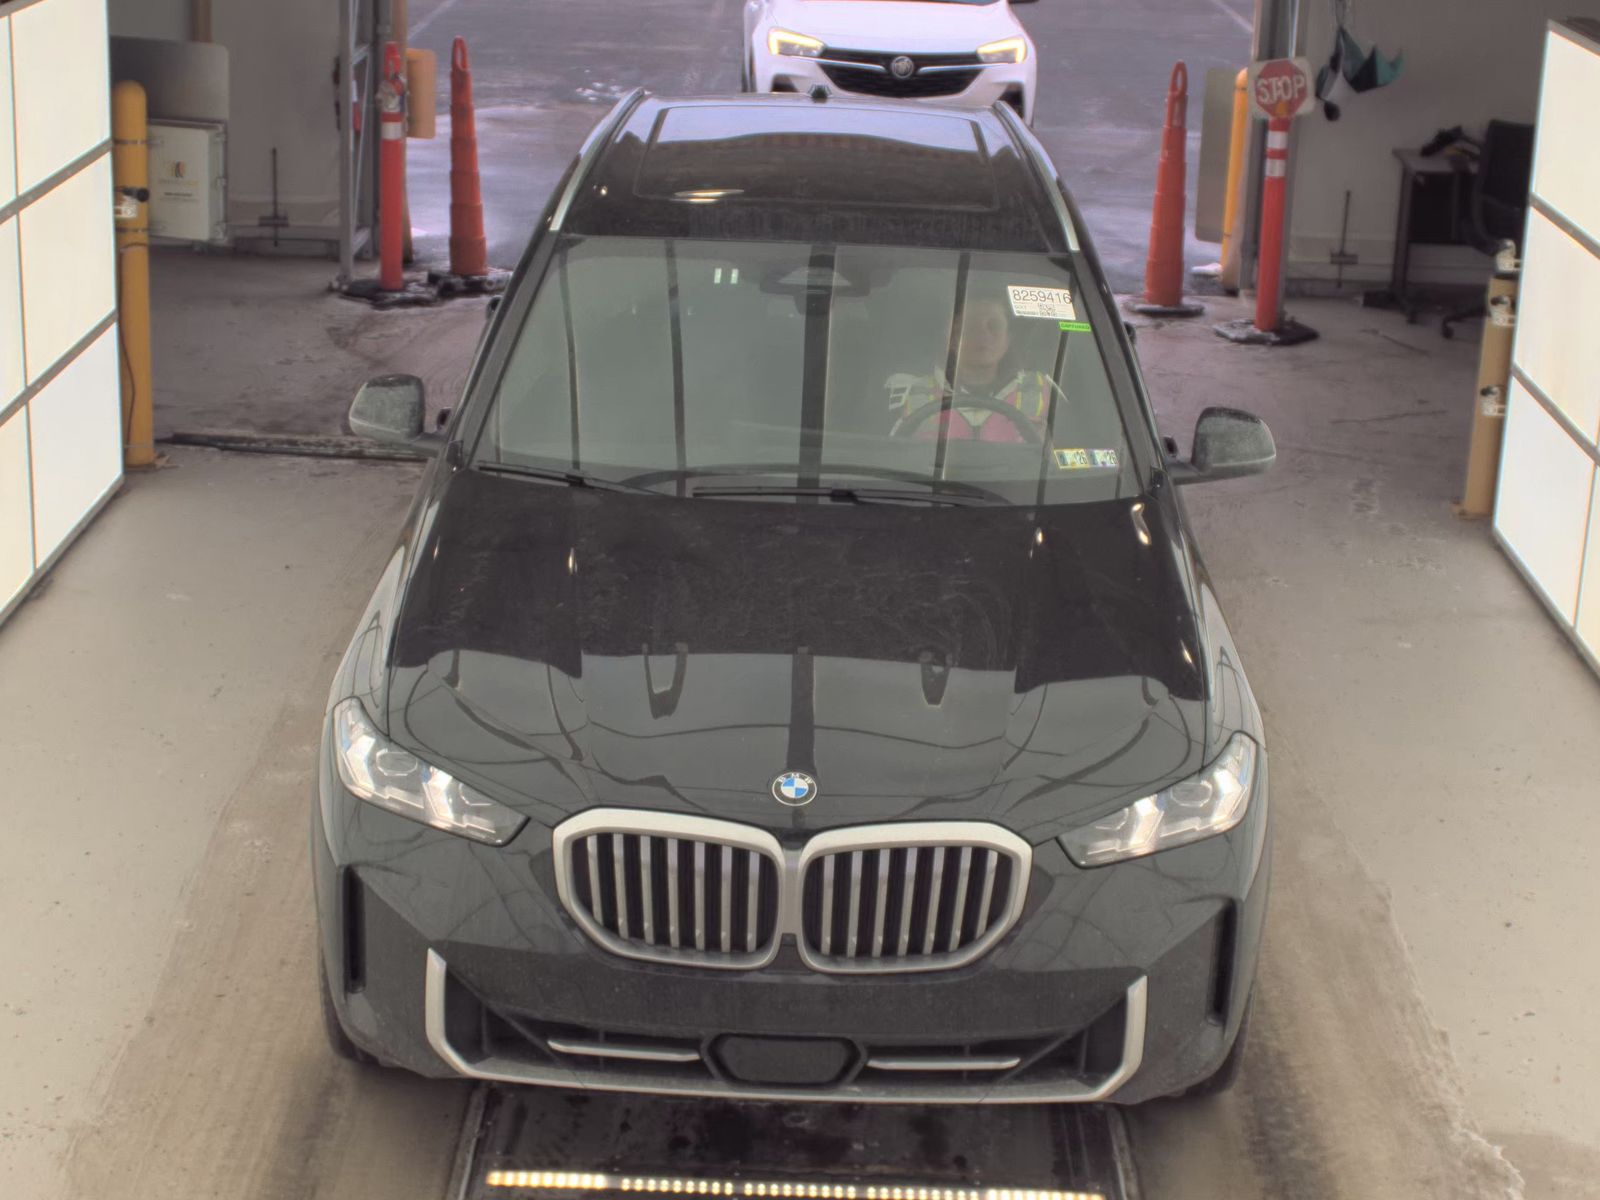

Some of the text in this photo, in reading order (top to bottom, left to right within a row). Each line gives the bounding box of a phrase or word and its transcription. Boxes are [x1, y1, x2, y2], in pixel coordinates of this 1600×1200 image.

[1257, 74, 1306, 103] STOP
[1012, 289, 1072, 304] 8259416
[778, 772, 813, 784] BMW
